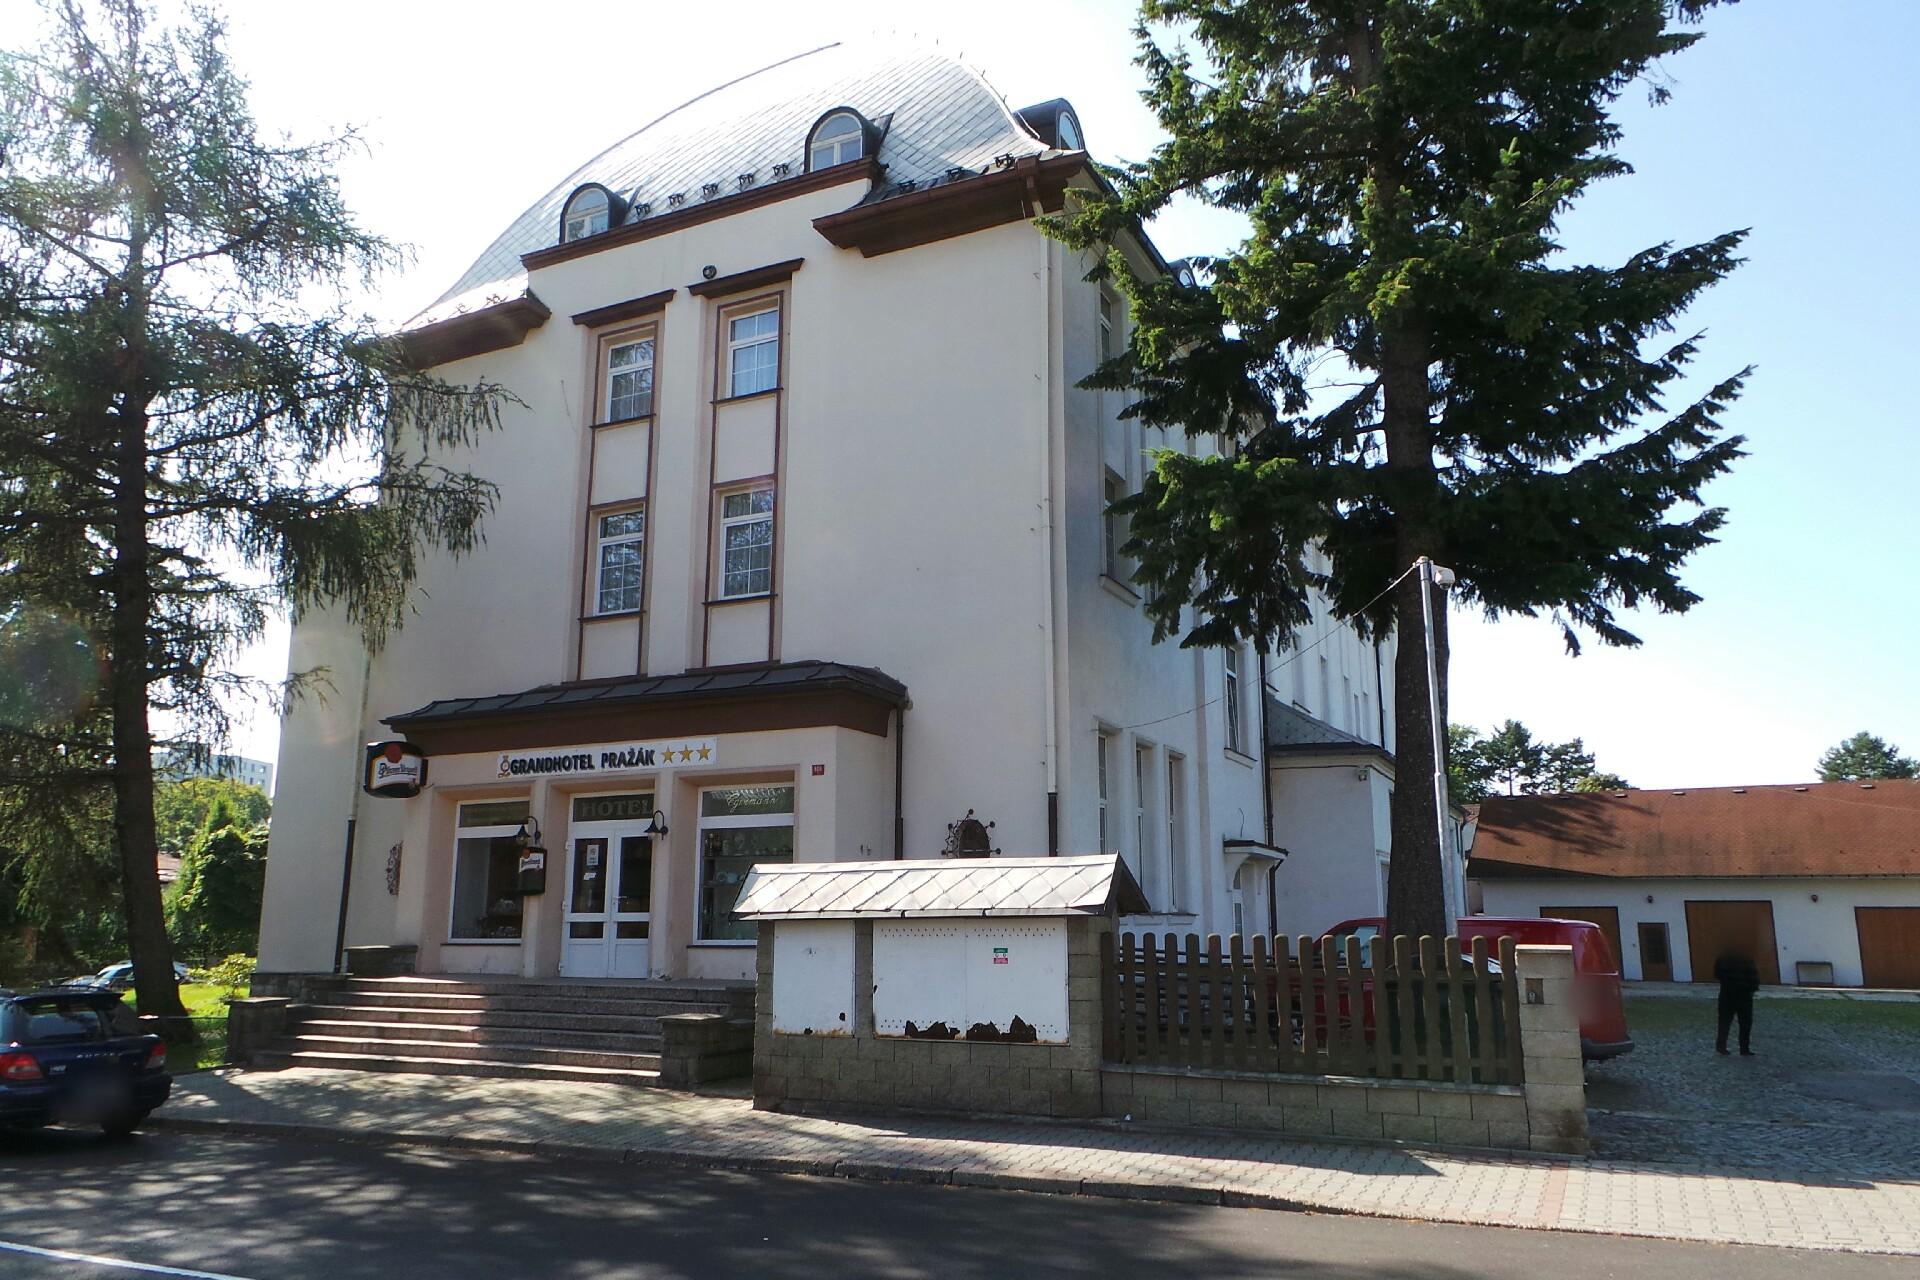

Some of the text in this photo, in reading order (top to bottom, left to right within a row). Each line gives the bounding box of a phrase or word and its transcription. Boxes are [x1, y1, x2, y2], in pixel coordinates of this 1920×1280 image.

[511, 746, 656, 775] GRANDHOTEL PRAŽÁK
[581, 799, 652, 817] HOTEL
